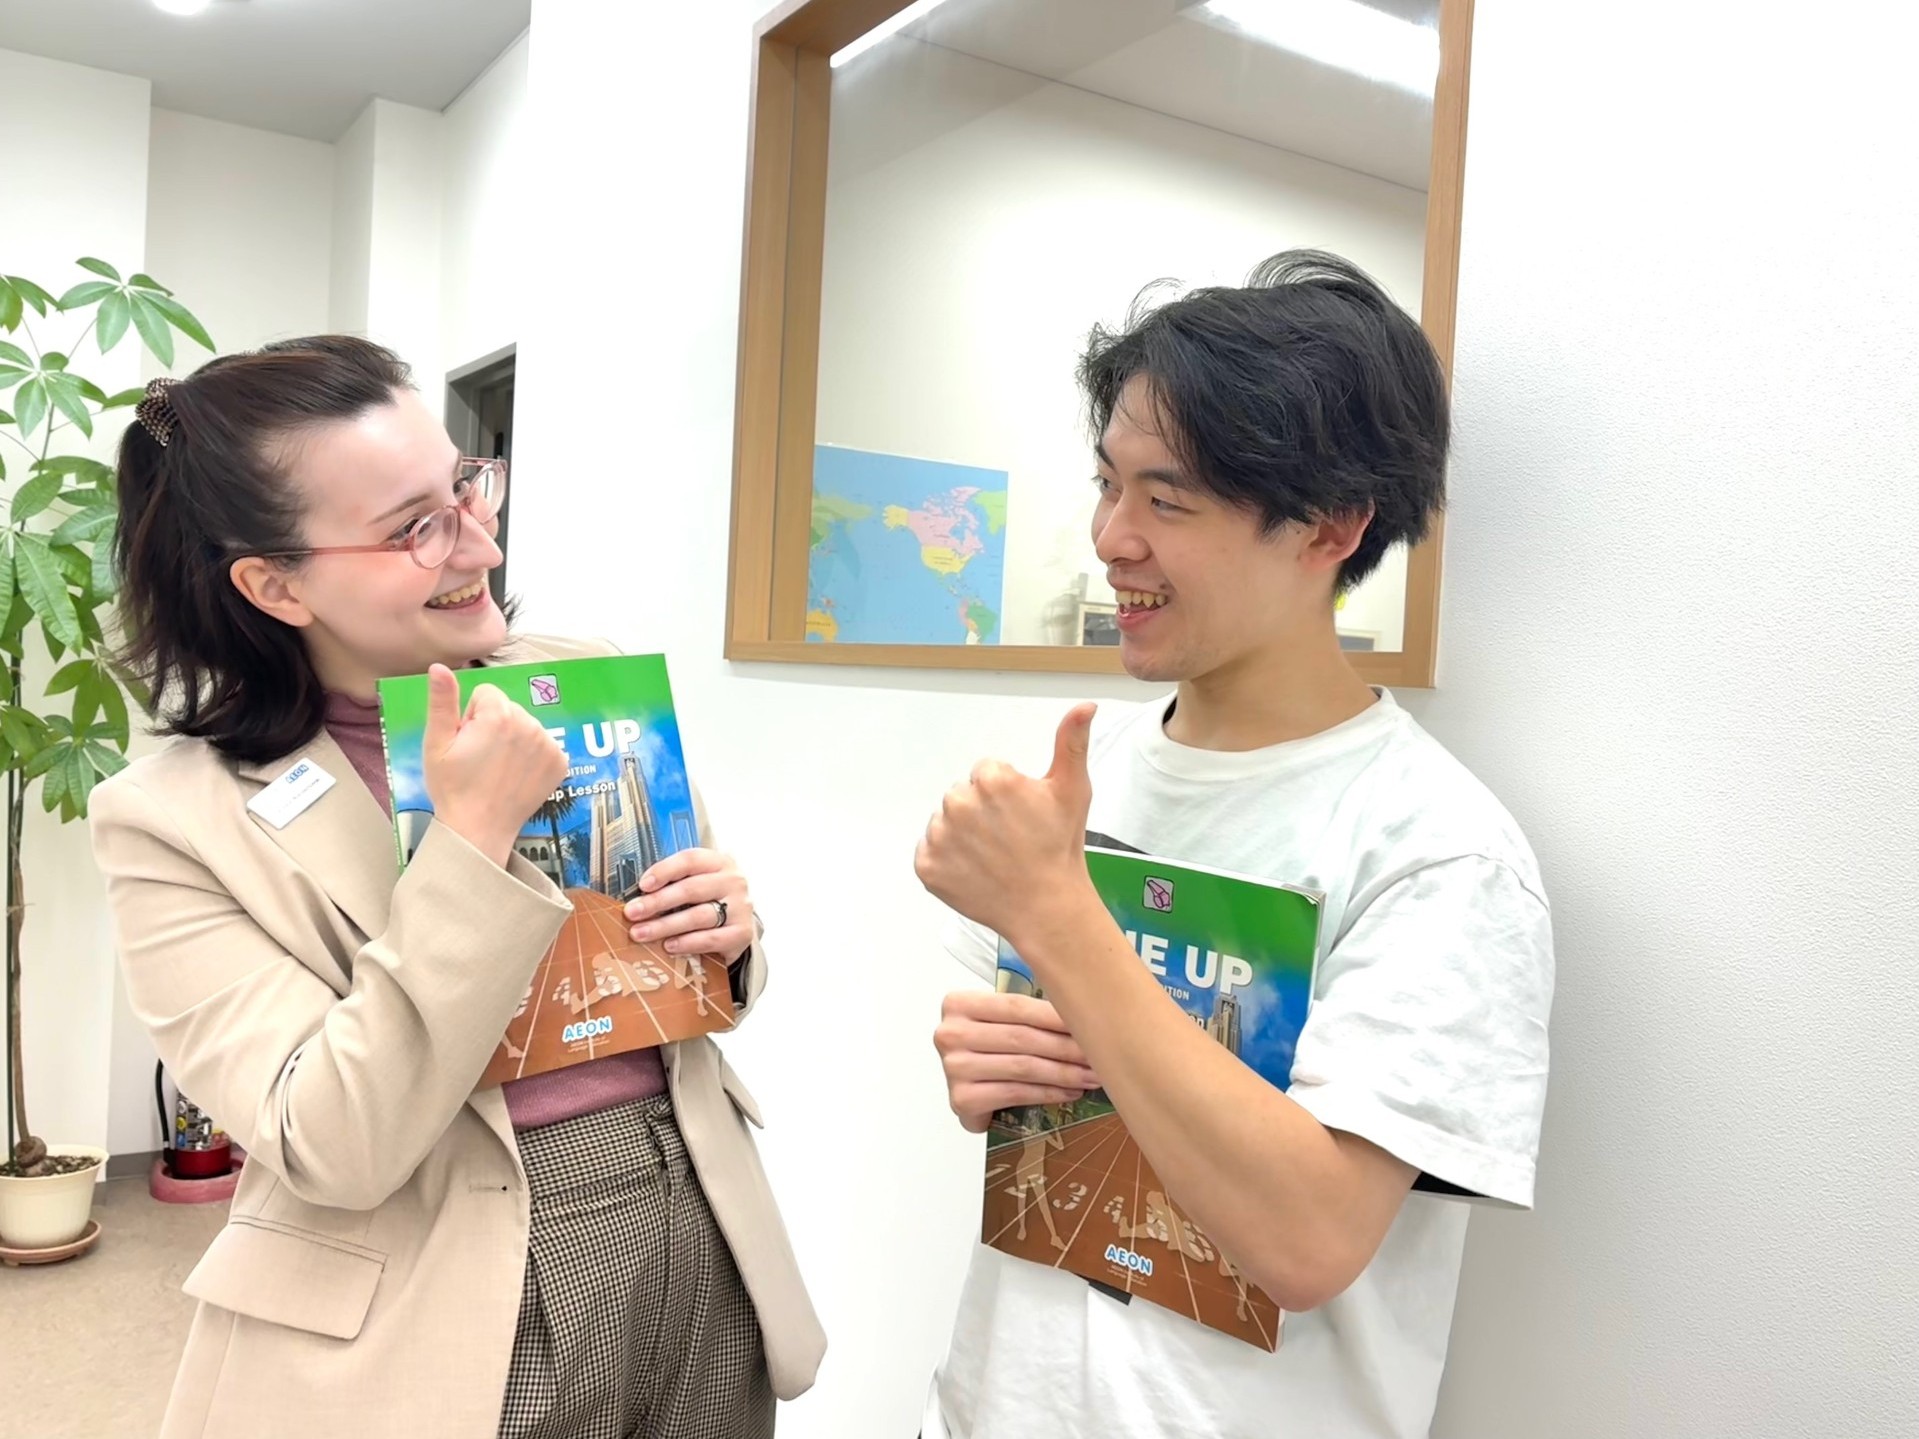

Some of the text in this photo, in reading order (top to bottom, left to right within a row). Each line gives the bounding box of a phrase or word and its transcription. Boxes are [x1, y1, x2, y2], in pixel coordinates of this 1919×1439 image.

[582, 719, 641, 758] UP
[568, 781, 616, 797] Lesson
[1184, 944, 1253, 995] UP
[563, 1017, 612, 1042] AEON
[1105, 1245, 1152, 1275] AEON
